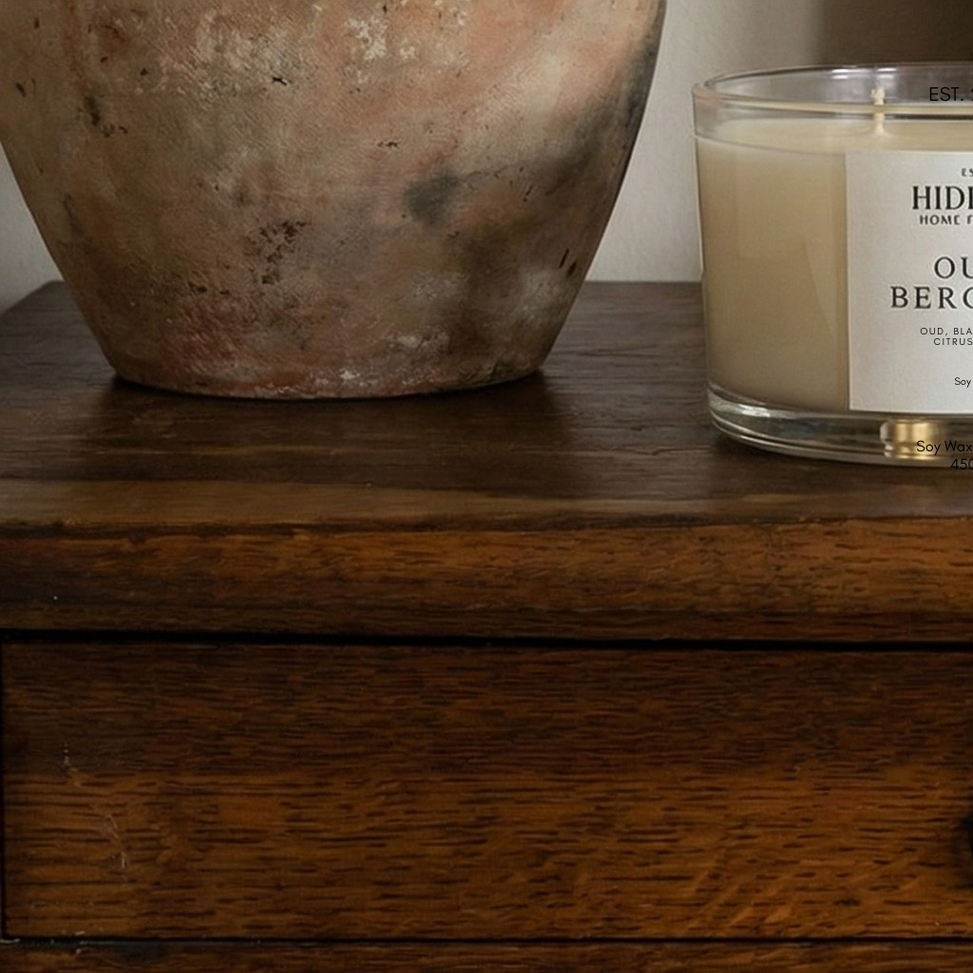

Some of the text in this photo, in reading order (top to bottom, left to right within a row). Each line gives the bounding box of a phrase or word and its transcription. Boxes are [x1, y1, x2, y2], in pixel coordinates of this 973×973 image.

[919, 214, 961, 226] HOME
[919, 327, 949, 337] OUD,
[933, 337, 973, 347] CITRUS
[954, 376, 972, 389] Soy
